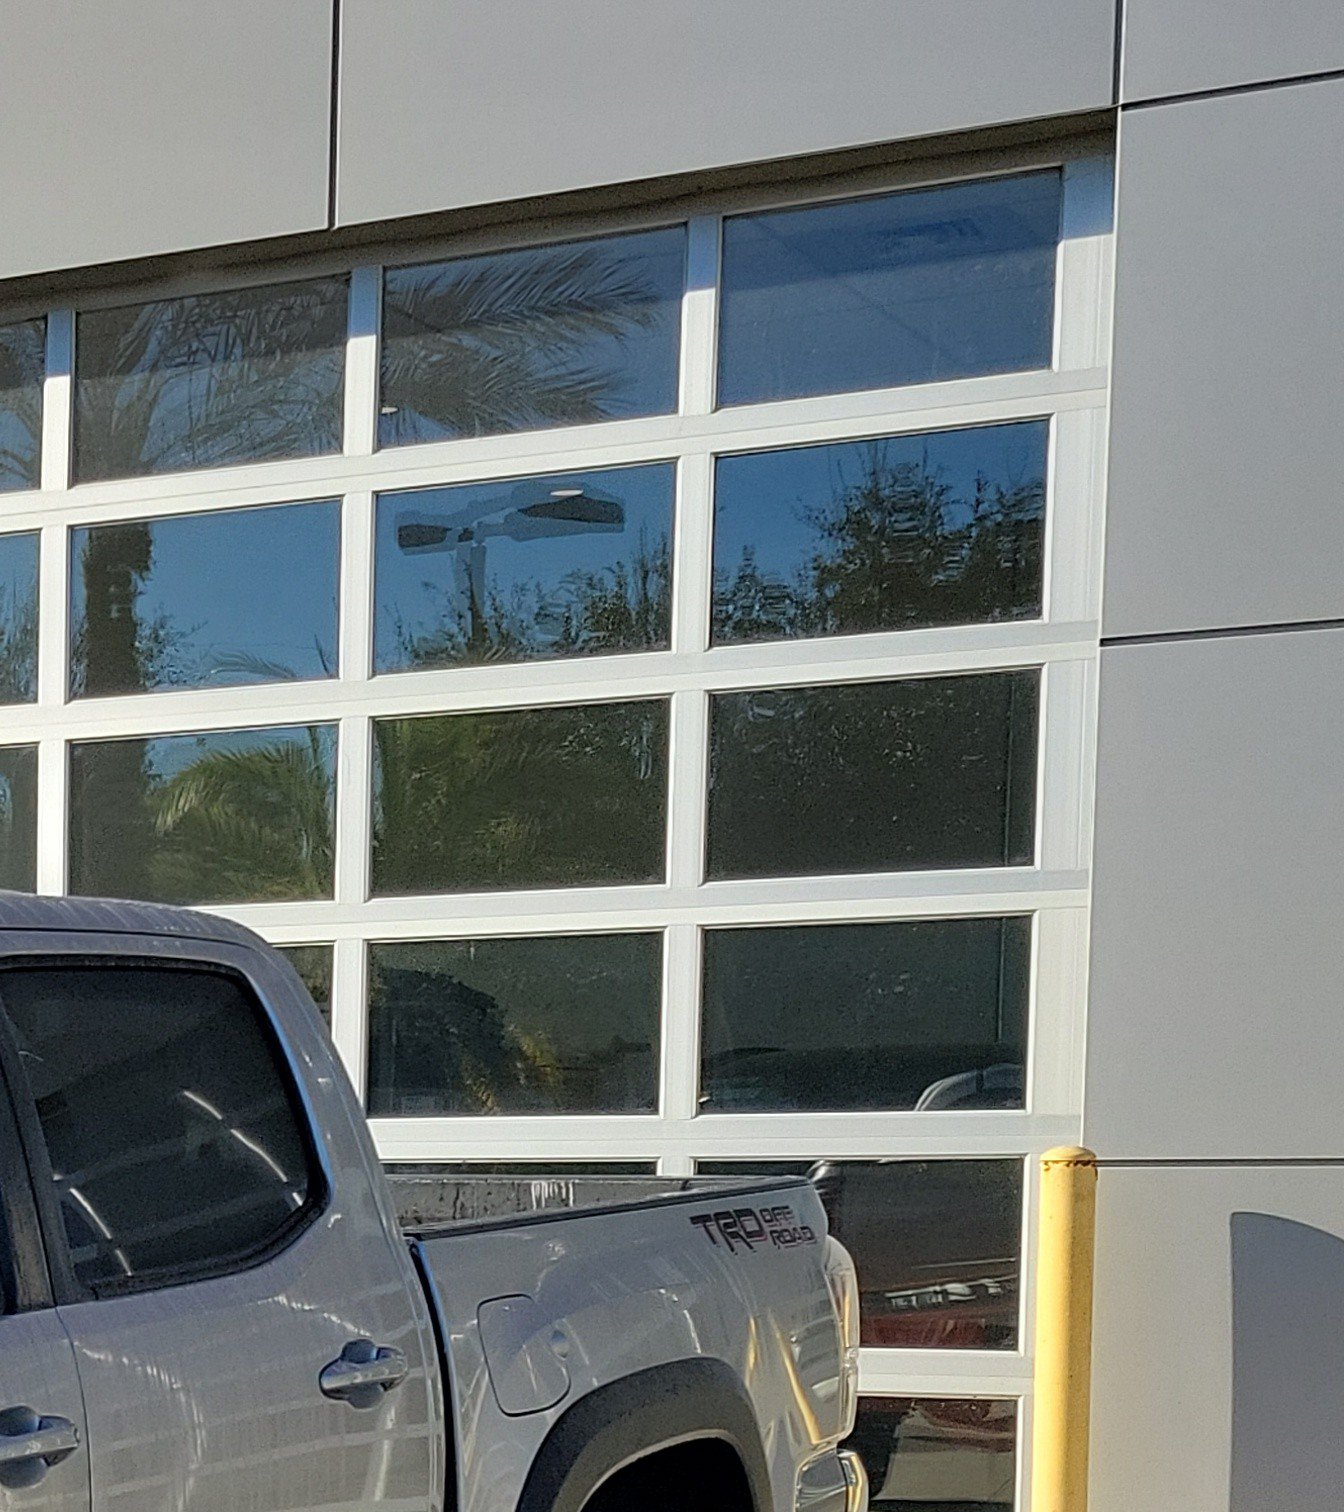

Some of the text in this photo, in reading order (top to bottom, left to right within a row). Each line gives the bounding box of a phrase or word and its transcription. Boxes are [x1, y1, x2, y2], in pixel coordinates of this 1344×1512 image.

[689, 1205, 795, 1253] TRD OFF
[769, 1225, 816, 1249] ROAD
